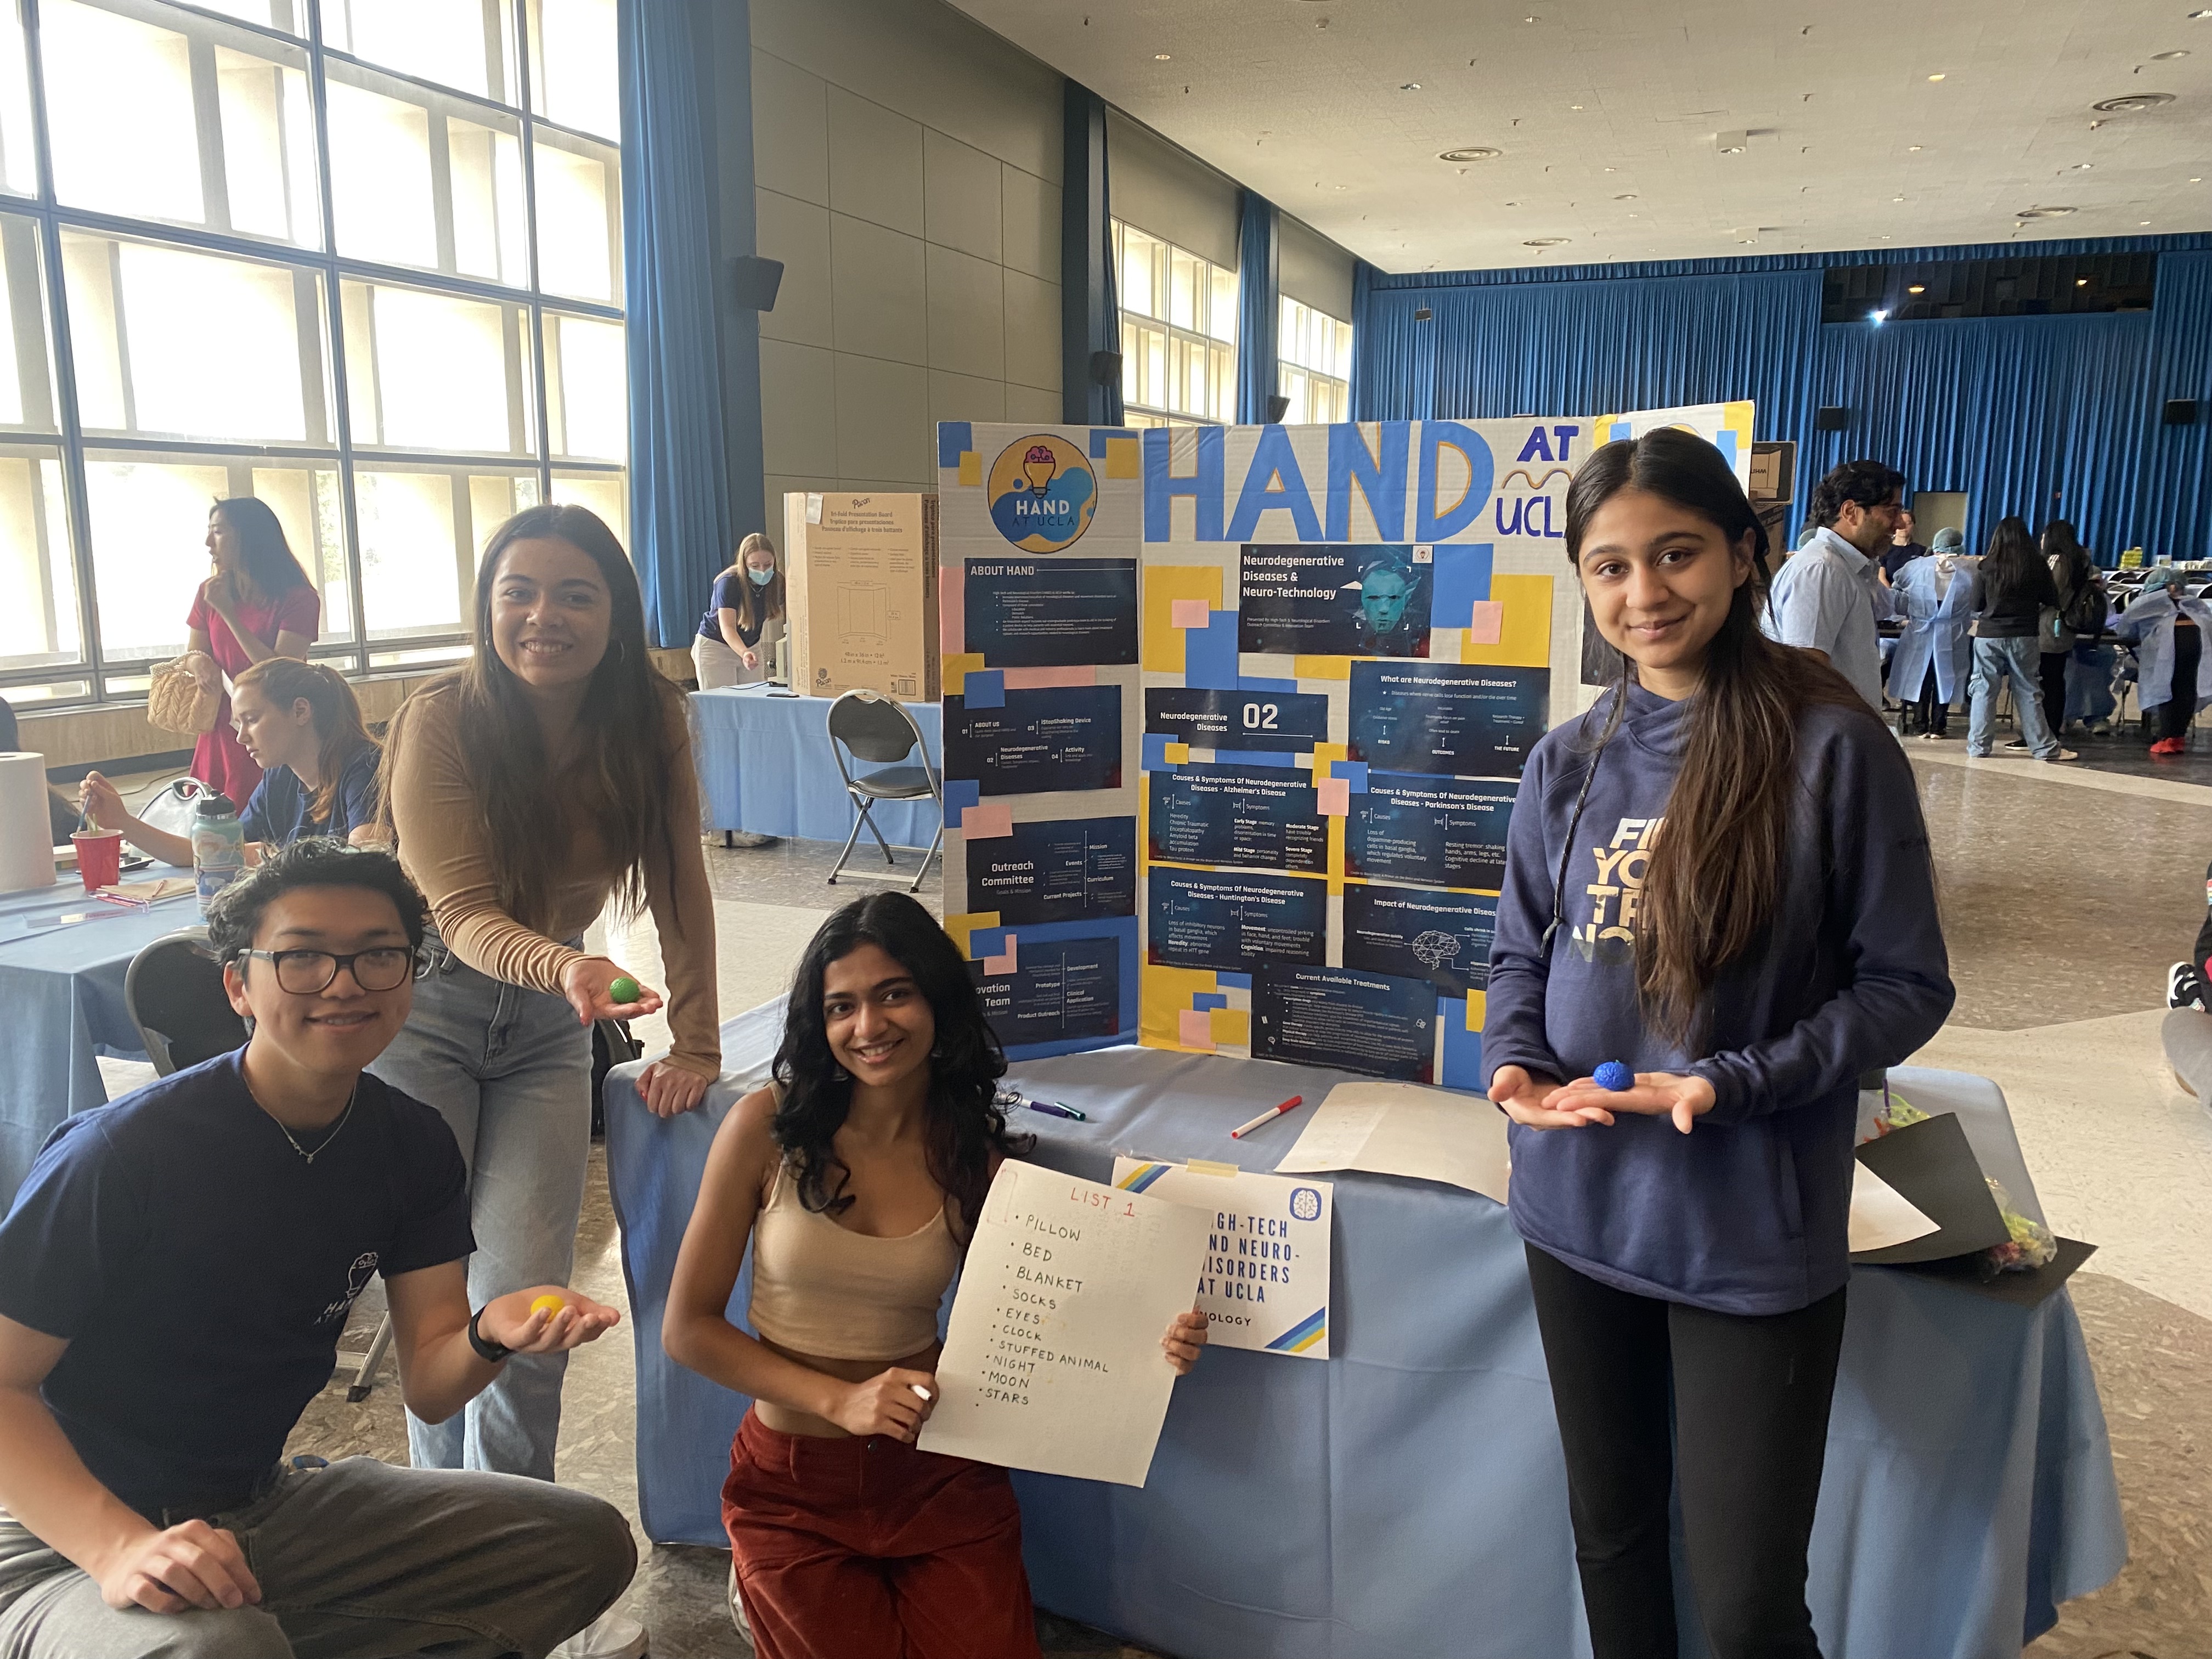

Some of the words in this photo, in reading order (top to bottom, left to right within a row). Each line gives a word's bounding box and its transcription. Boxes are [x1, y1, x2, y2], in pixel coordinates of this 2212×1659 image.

[1516, 426, 1579, 462] AT
[1144, 420, 1494, 542] HAND
[1016, 500, 1069, 515] HAND
[1012, 516, 1030, 526] AT
[1037, 516, 1075, 526] UCLA
[1496, 495, 1569, 539] UCL
[1243, 555, 1344, 567] Neurodegenerative
[970, 566, 1003, 576] ABOUT
[1007, 565, 1034, 575] HAND
[1243, 571, 1288, 582] Diseases
[1290, 572, 1298, 582] &
[1243, 587, 1336, 600] Neuro-Technology
[1413, 677, 1480, 686] Neurodegenerative
[1160, 712, 1227, 721] Neurodegenerative
[1243, 703, 1278, 729] 02
[1197, 723, 1227, 731] Diseases
[1201, 776, 1235, 785] Symptoms
[1245, 778, 1307, 789] Neurodegenerative
[1223, 786, 1260, 795] Alzheimer's
[1261, 788, 1286, 797] Disease
[1370, 787, 1394, 795] Causes
[1402, 789, 1438, 799] Symptoms
[1449, 792, 1516, 804] Neurodegenerative
[1391, 798, 1419, 806] Diseases
[1425, 801, 1465, 810] Parkinson's
[1466, 803, 1494, 811] Disease
[1367, 836, 1416, 847] dopamine-producing
[991, 861, 1034, 872] Outreach
[1593, 848, 1653, 889] YO
[981, 876, 1034, 887] Committee
[1199, 883, 1233, 893] Symptoms
[1243, 886, 1304, 897] Neurodegenerative
[1188, 891, 1214, 900] Diseases
[1220, 894, 1260, 903] Huntington's
[1261, 896, 1286, 905] Disease
[1374, 899, 1397, 908] Impact
[1407, 902, 1472, 915] Neurodegenerative
[1474, 907, 1496, 916] Diseas
[975, 983, 1011, 995] ovation
[1295, 973, 1320, 981] Current
[1322, 975, 1352, 985] Available
[1353, 979, 1390, 991] Treatments
[985, 997, 1011, 1007] Team
[1070, 1187, 1111, 1210] LIST
[1123, 1202, 1136, 1217] 1
[1026, 1214, 1081, 1241] PILLOW
[1211, 1212, 1287, 1238] GH-TECH
[1023, 1242, 1052, 1261] BED
[1209, 1234, 1228, 1252] ND
[1239, 1238, 1299, 1261] NEURO-
[1203, 1256, 1289, 1284] ISORDERS
[1017, 1266, 1082, 1293] BLANKET
[1198, 1277, 1215, 1295] AT
[1226, 1281, 1265, 1303] UCLA
[1013, 1288, 1057, 1310] SOCKS
[1006, 1308, 1040, 1324] EYES
[1200, 1311, 1251, 1326] OLOGY
[1002, 1324, 1042, 1341] CLOCK
[993, 1355, 1036, 1374] NIGHT
[998, 1340, 1054, 1362] STUFFED
[1059, 1354, 1109, 1373] ANIMAL
[989, 1372, 1030, 1389] MOON
[985, 1388, 1029, 1405] STARS
